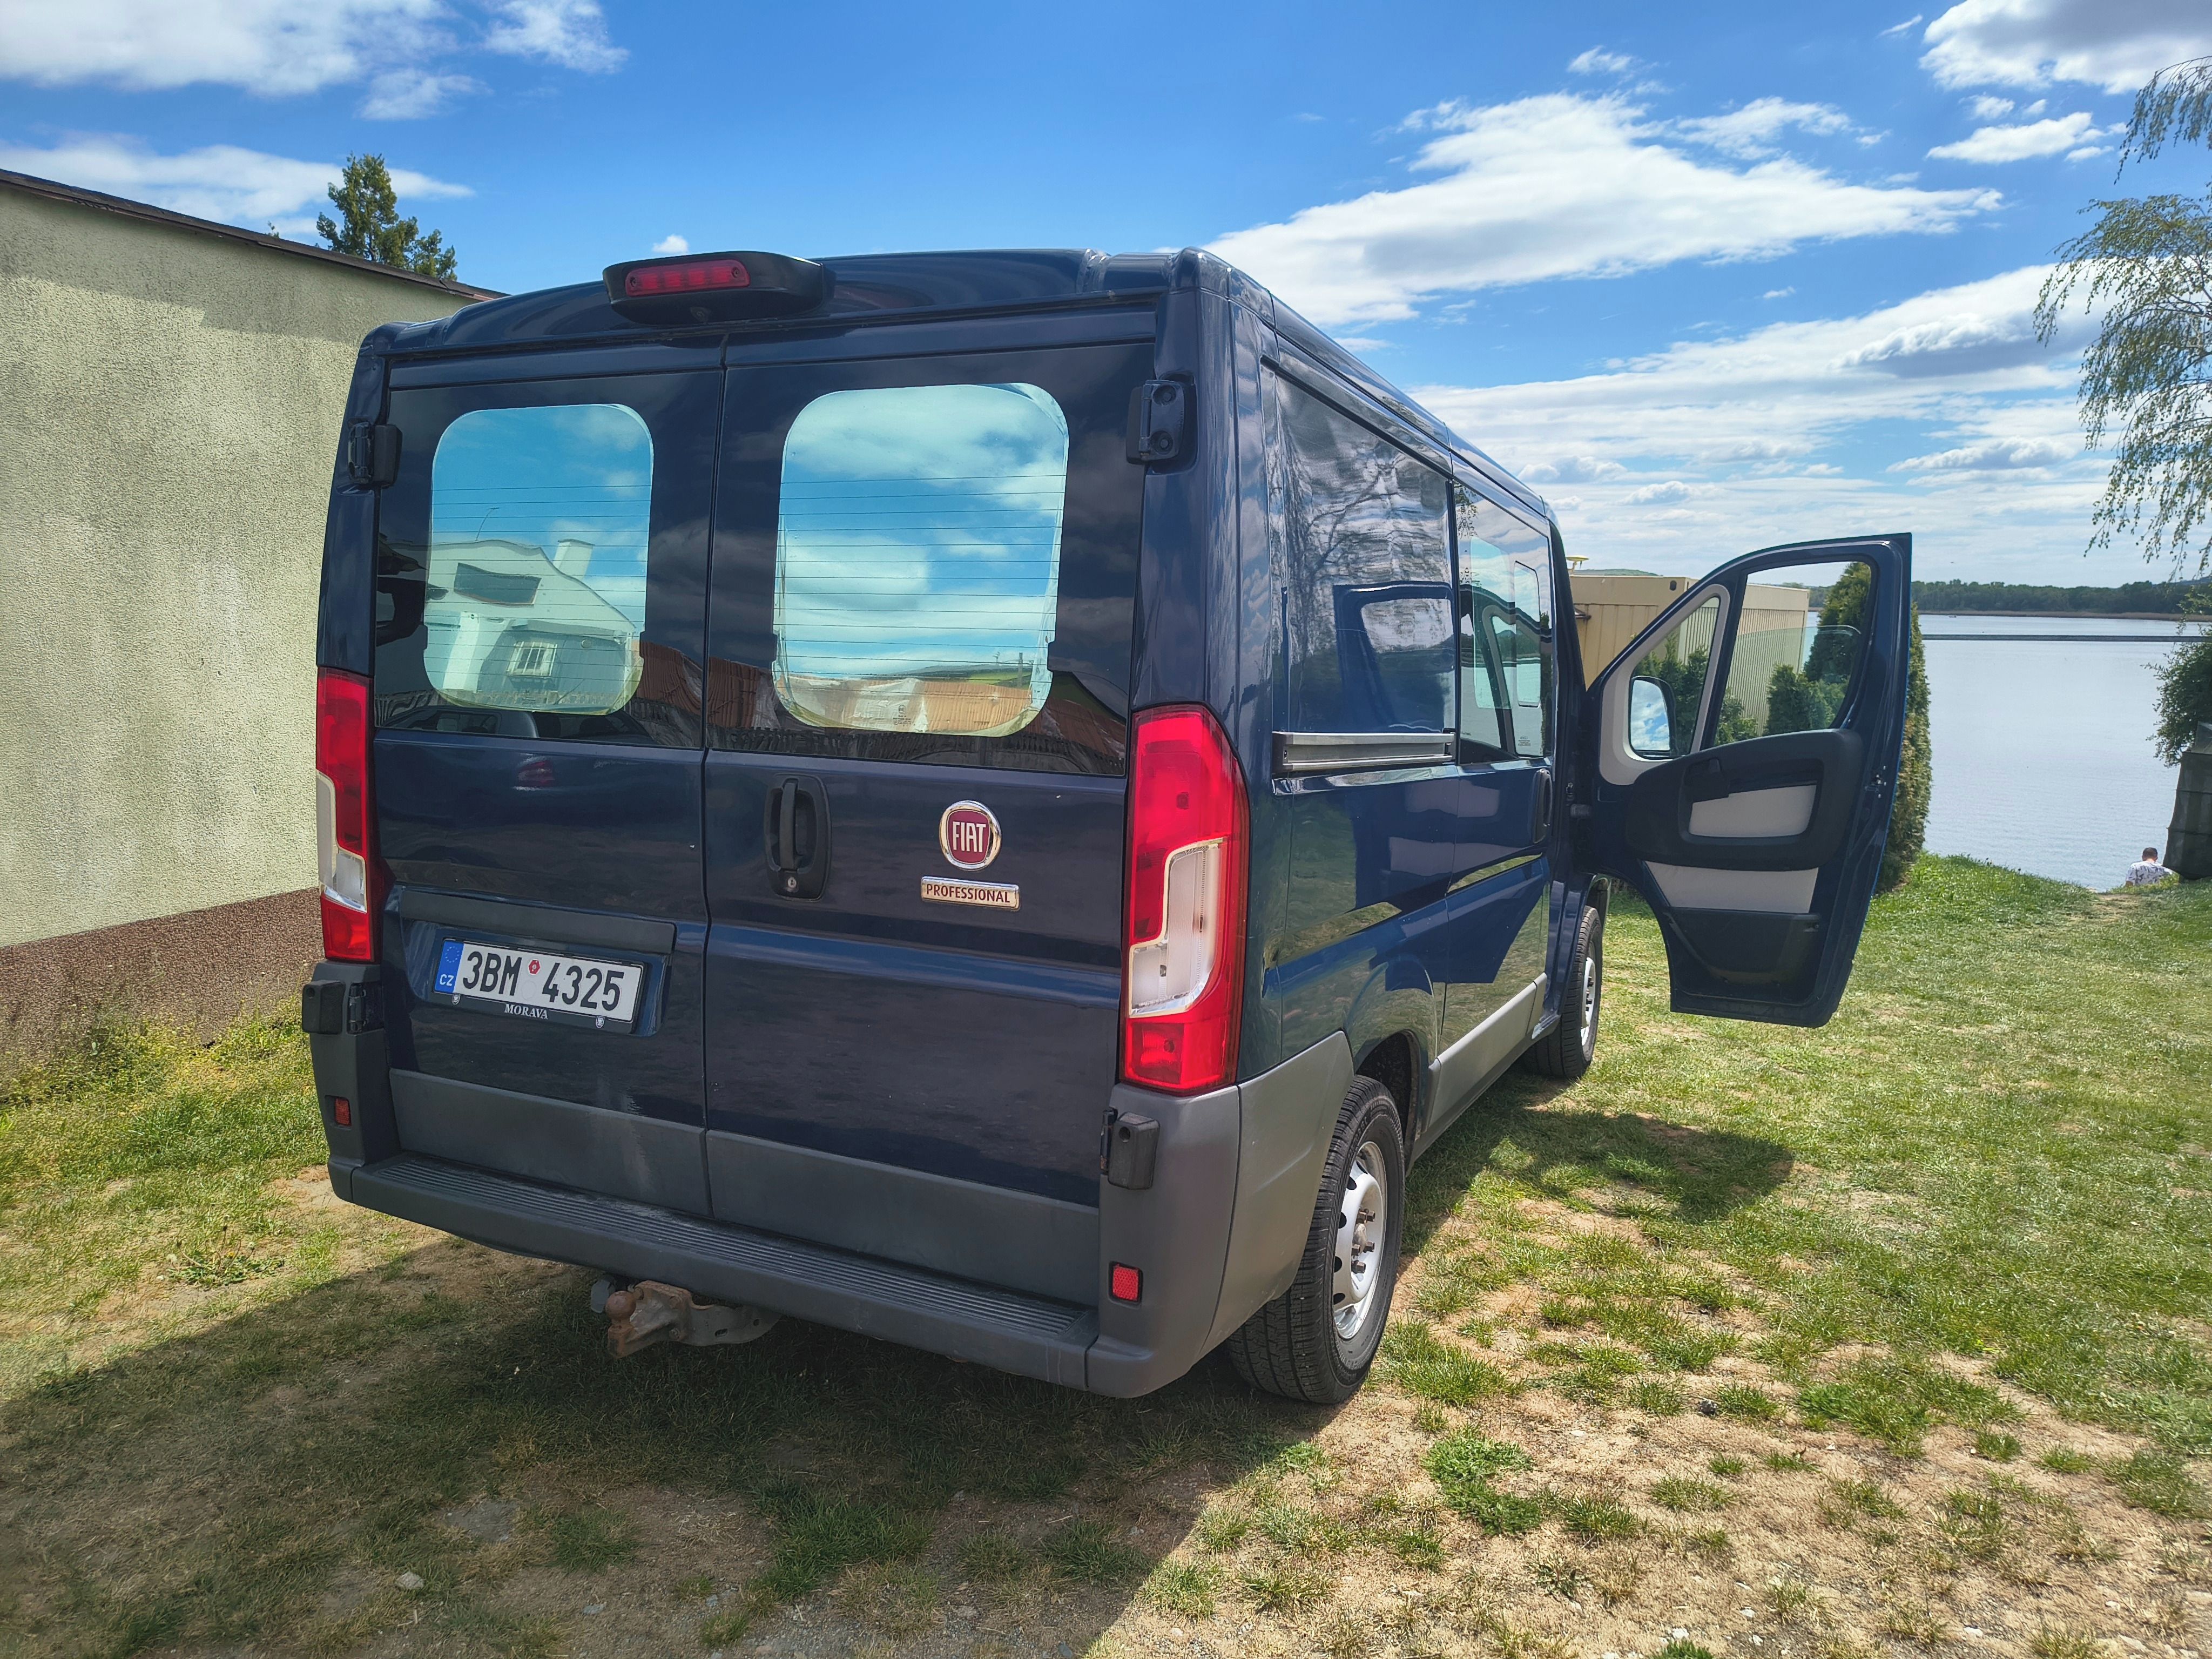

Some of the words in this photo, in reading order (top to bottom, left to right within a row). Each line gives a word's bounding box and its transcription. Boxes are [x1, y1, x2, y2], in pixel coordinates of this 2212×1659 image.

[952, 821, 987, 853] FIAT
[926, 884, 1010, 903] PROFESSIONAL
[439, 974, 454, 987] CZ
[462, 951, 522, 996] 3BM
[542, 962, 625, 1011] 4325
[504, 1003, 549, 1020] MORAVA
